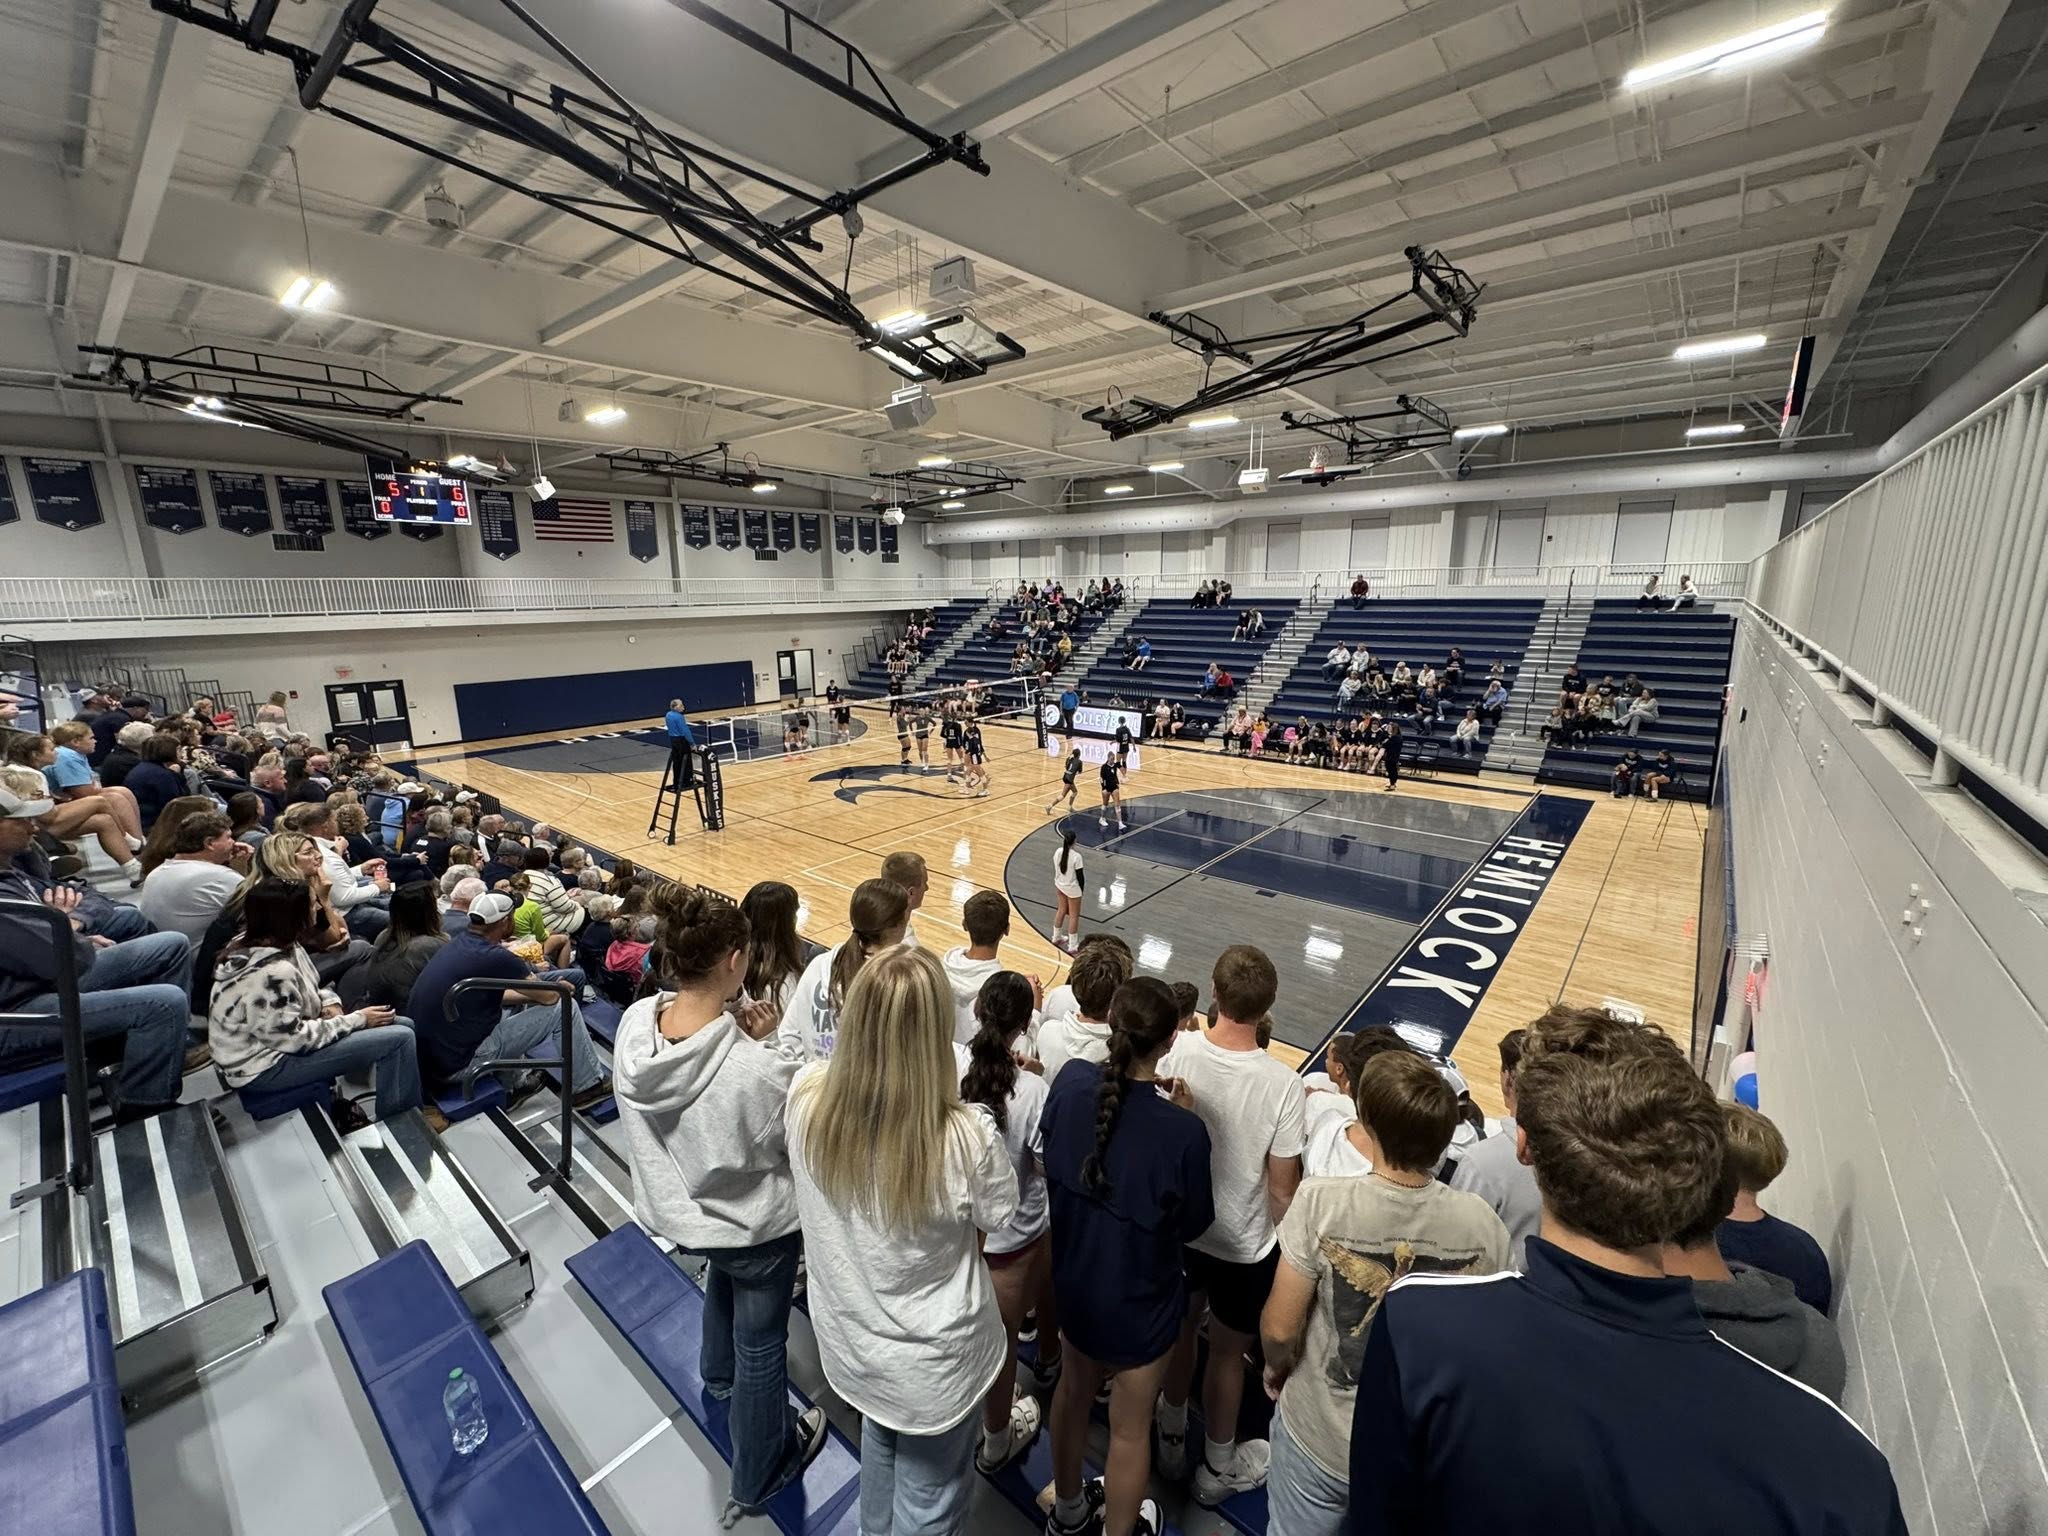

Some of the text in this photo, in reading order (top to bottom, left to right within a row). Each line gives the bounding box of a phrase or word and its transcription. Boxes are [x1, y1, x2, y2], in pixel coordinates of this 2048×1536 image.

[375, 473, 396, 481] HOME
[439, 478, 461, 486] GUEST
[389, 482, 400, 497] 5
[453, 487, 463, 500] 6
[381, 502, 390, 513] 0
[458, 507, 466, 517] 0
[1073, 711, 1140, 730] OLLEYBLL
[711, 763, 722, 828] HUSKIES
[1386, 835, 1566, 1009] HEMLOCK
